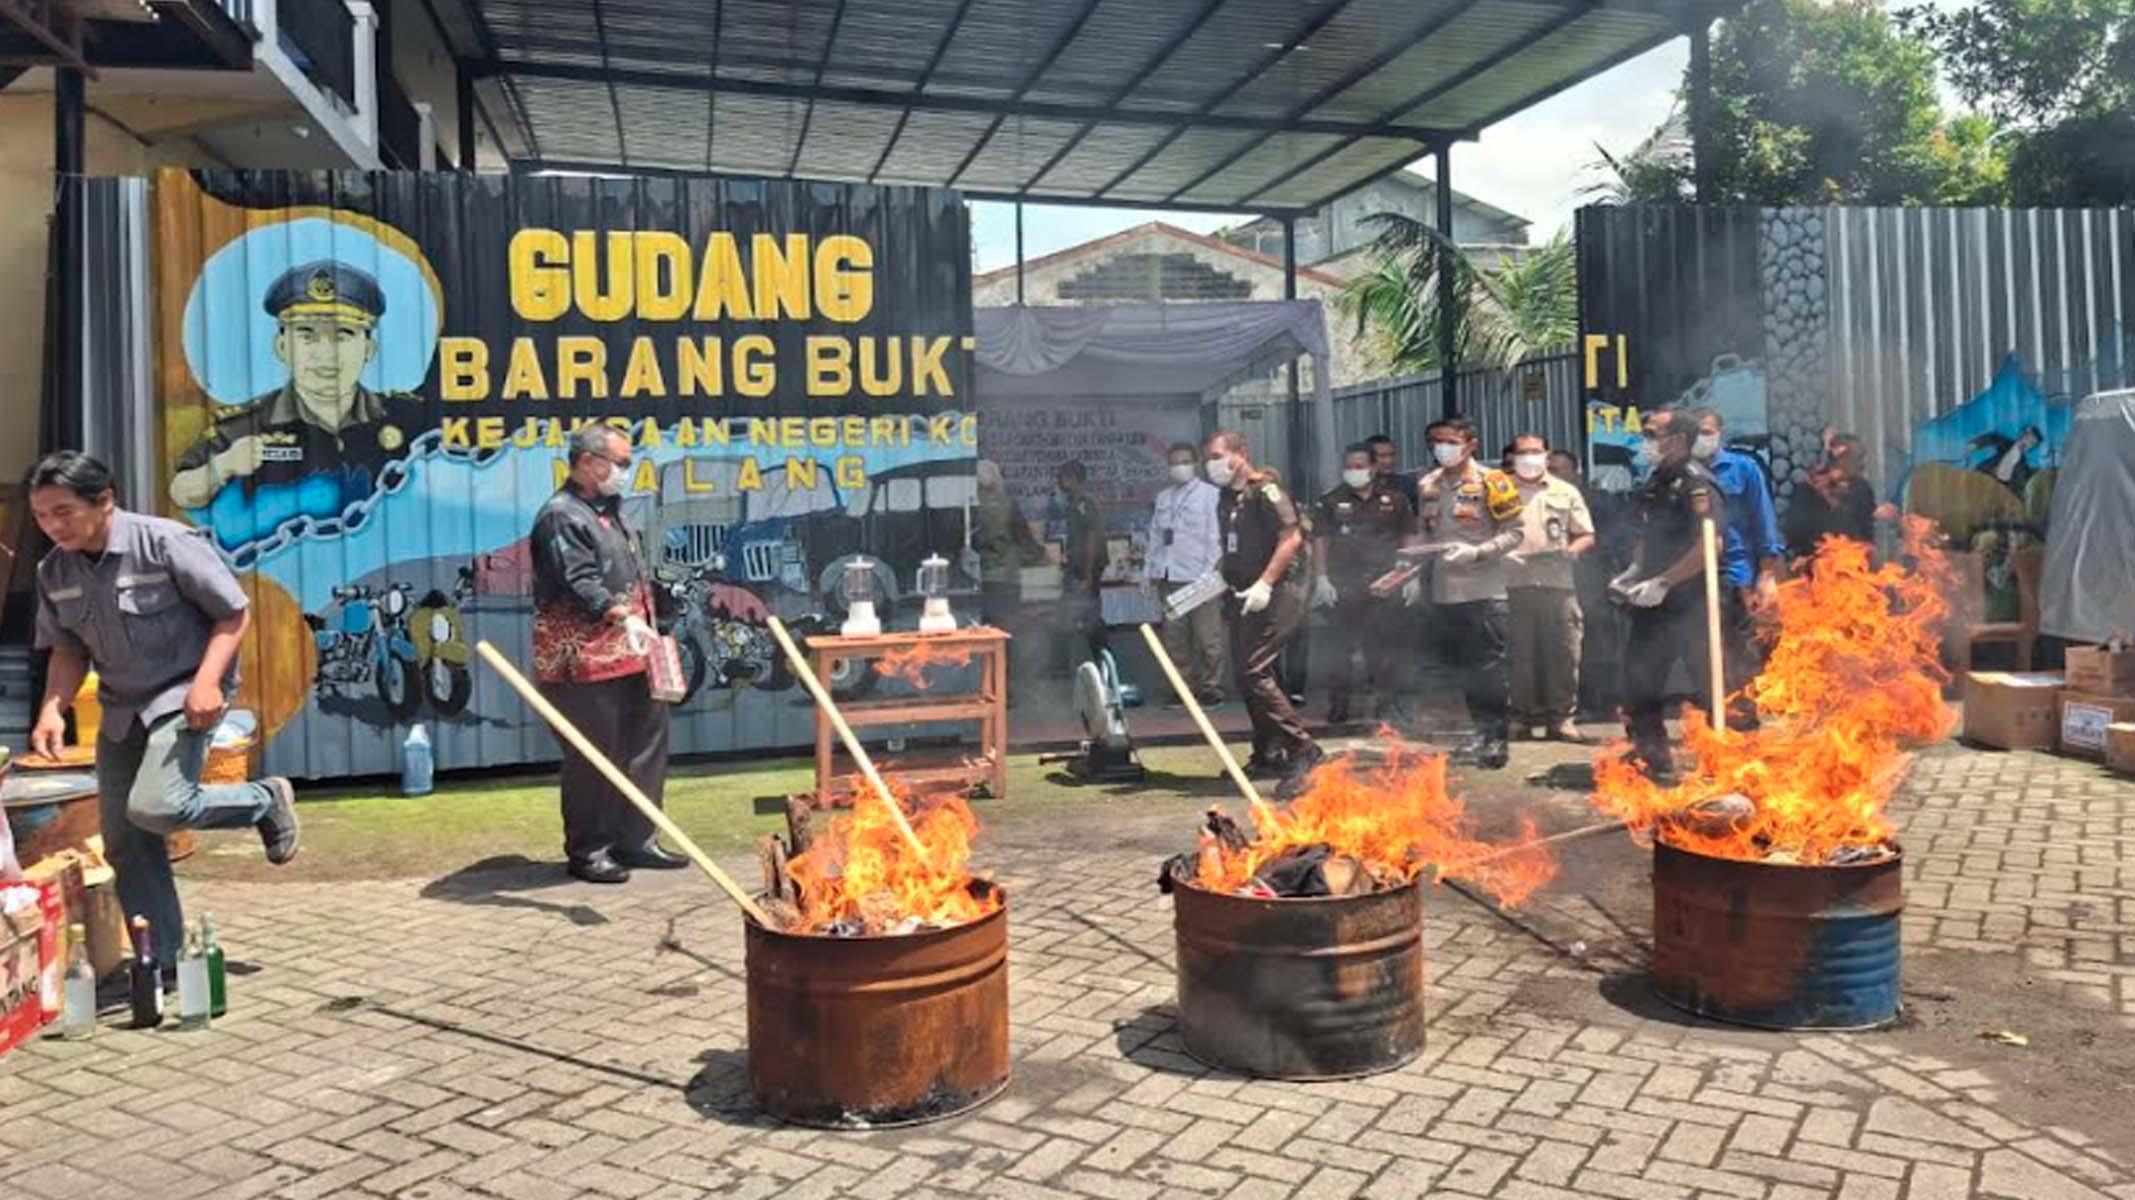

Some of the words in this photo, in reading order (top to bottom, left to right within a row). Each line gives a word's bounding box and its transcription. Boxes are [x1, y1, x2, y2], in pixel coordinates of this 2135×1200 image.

[508, 228, 874, 322] GUDANG
[440, 335, 777, 400] BARANG
[750, 415, 910, 448] NEGERI
[1586, 405, 1643, 434] TA
